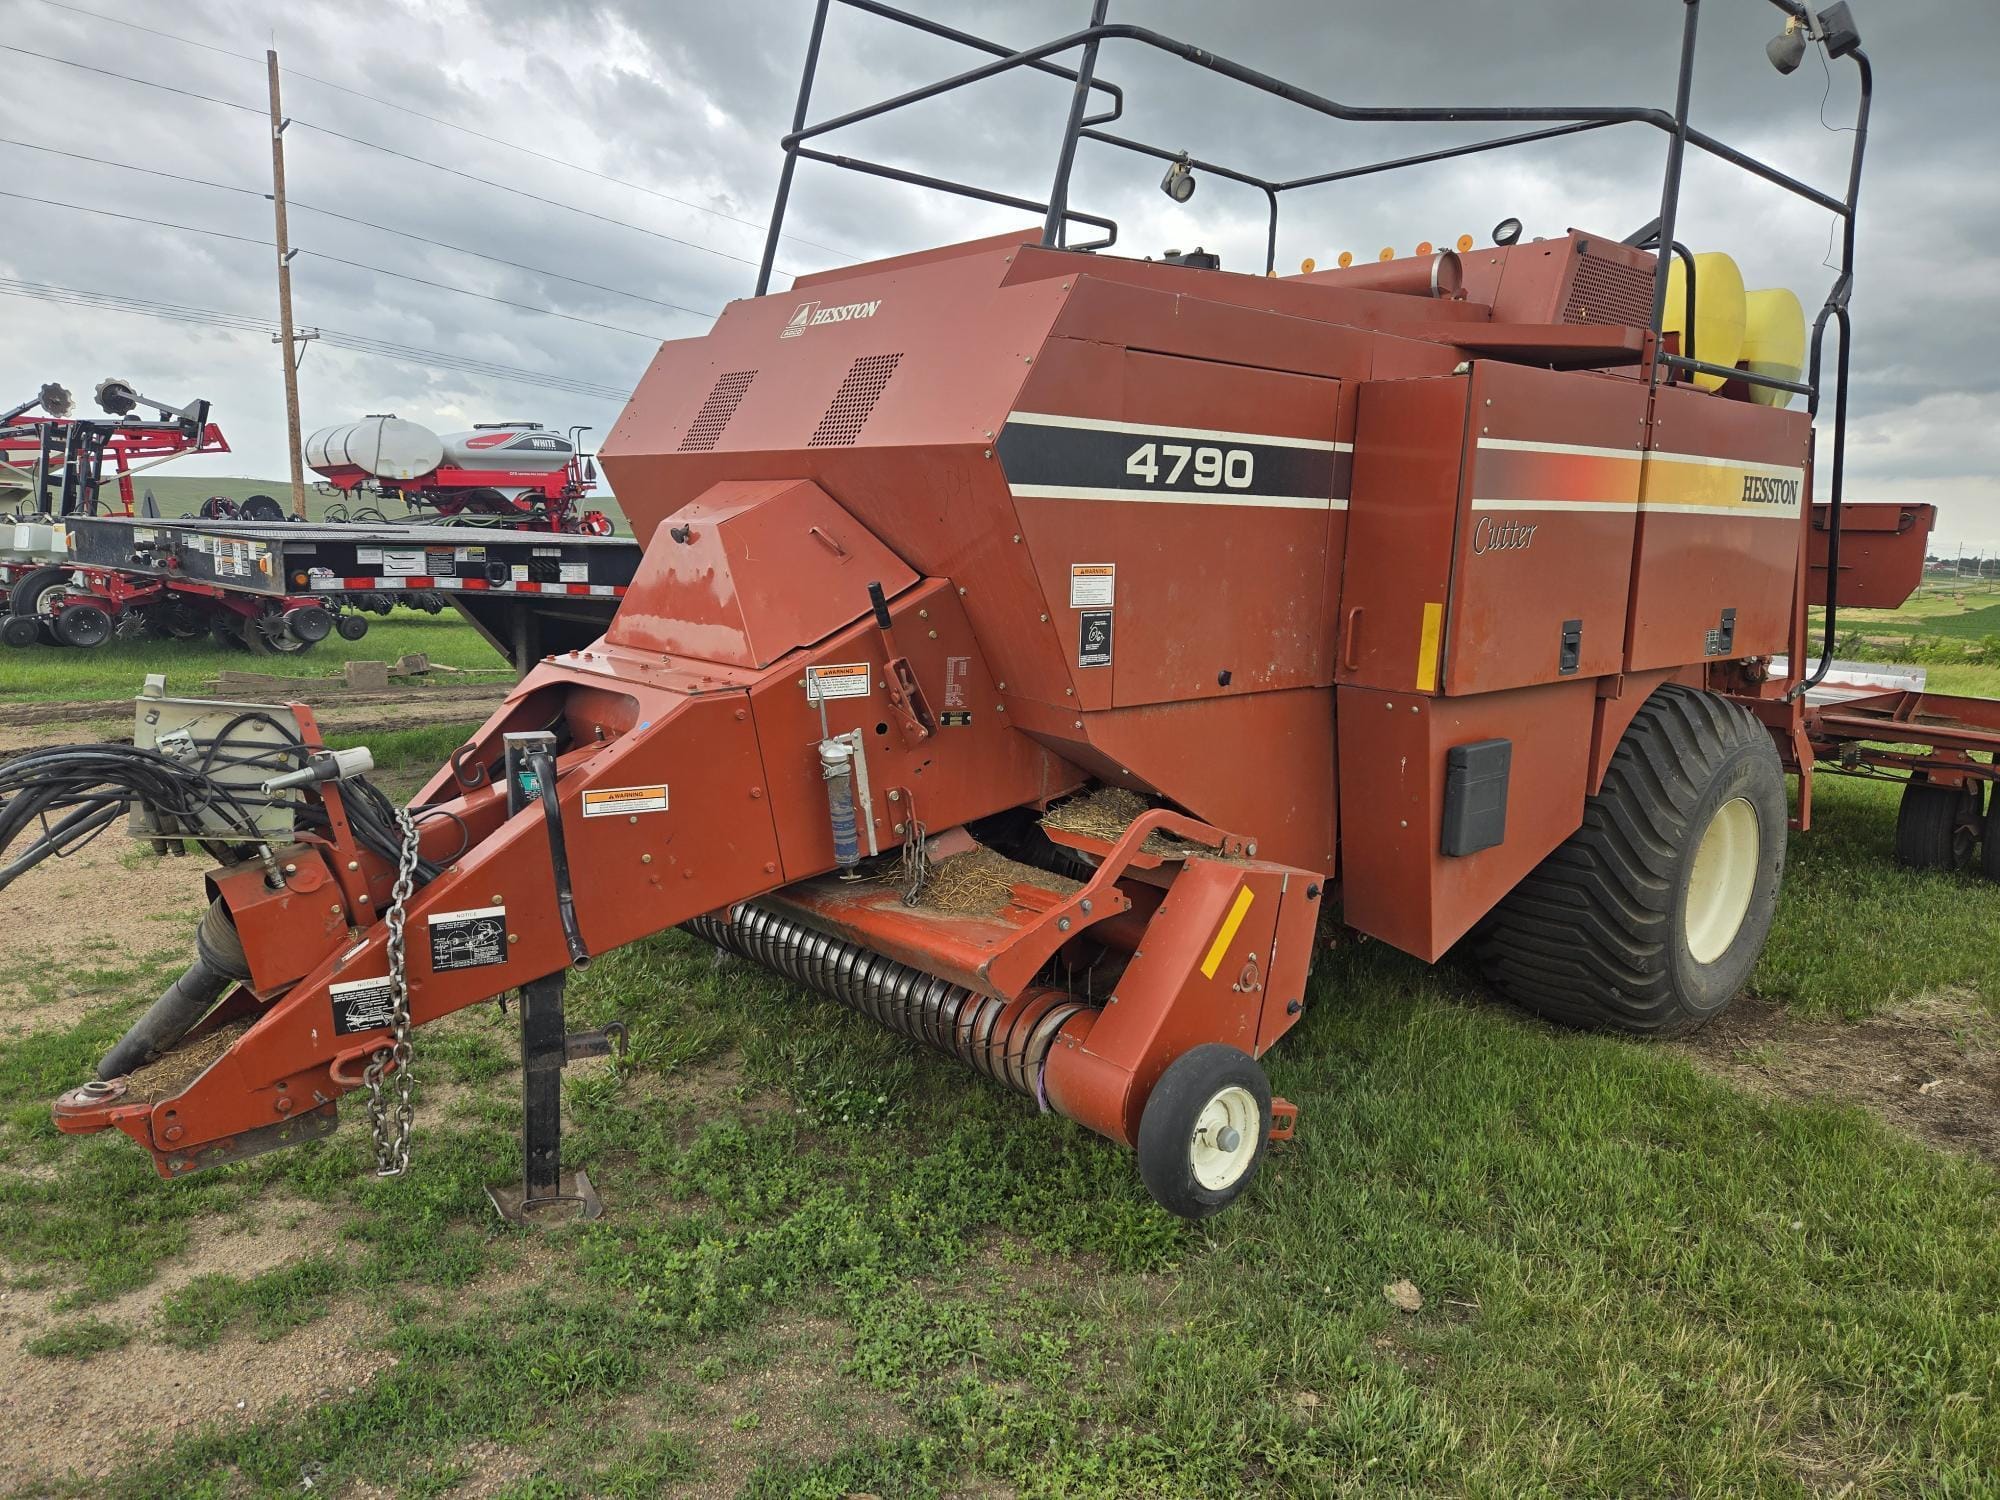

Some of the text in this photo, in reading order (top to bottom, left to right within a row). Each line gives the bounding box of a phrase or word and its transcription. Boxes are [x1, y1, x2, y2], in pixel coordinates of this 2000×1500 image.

[810, 300, 882, 325] HESSTON
[531, 438, 556, 448] WHITE
[1126, 443, 1254, 488] 4790
[1741, 475, 1799, 505] HESSTON
[1474, 516, 1538, 555] Cutter
[828, 668, 854, 676] WARNING
[614, 791, 644, 799] WARNING
[456, 911, 478, 919] NOTICE
